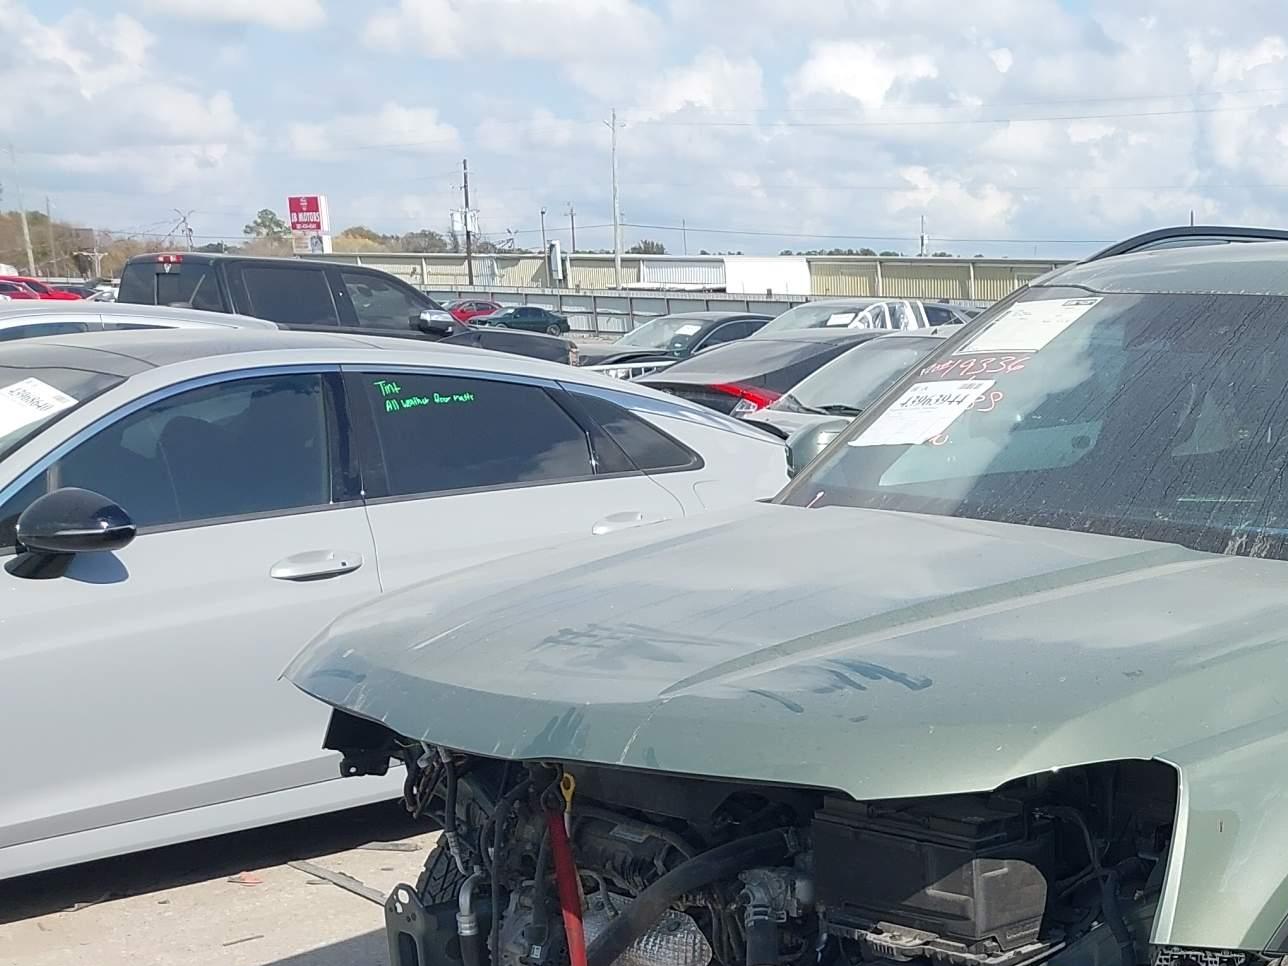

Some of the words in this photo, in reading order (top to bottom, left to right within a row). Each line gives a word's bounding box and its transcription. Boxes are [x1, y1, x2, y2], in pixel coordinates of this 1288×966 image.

[298, 212, 320, 223] MOTORS
[374, 380, 401, 396] Tint
[385, 399, 400, 412] All
